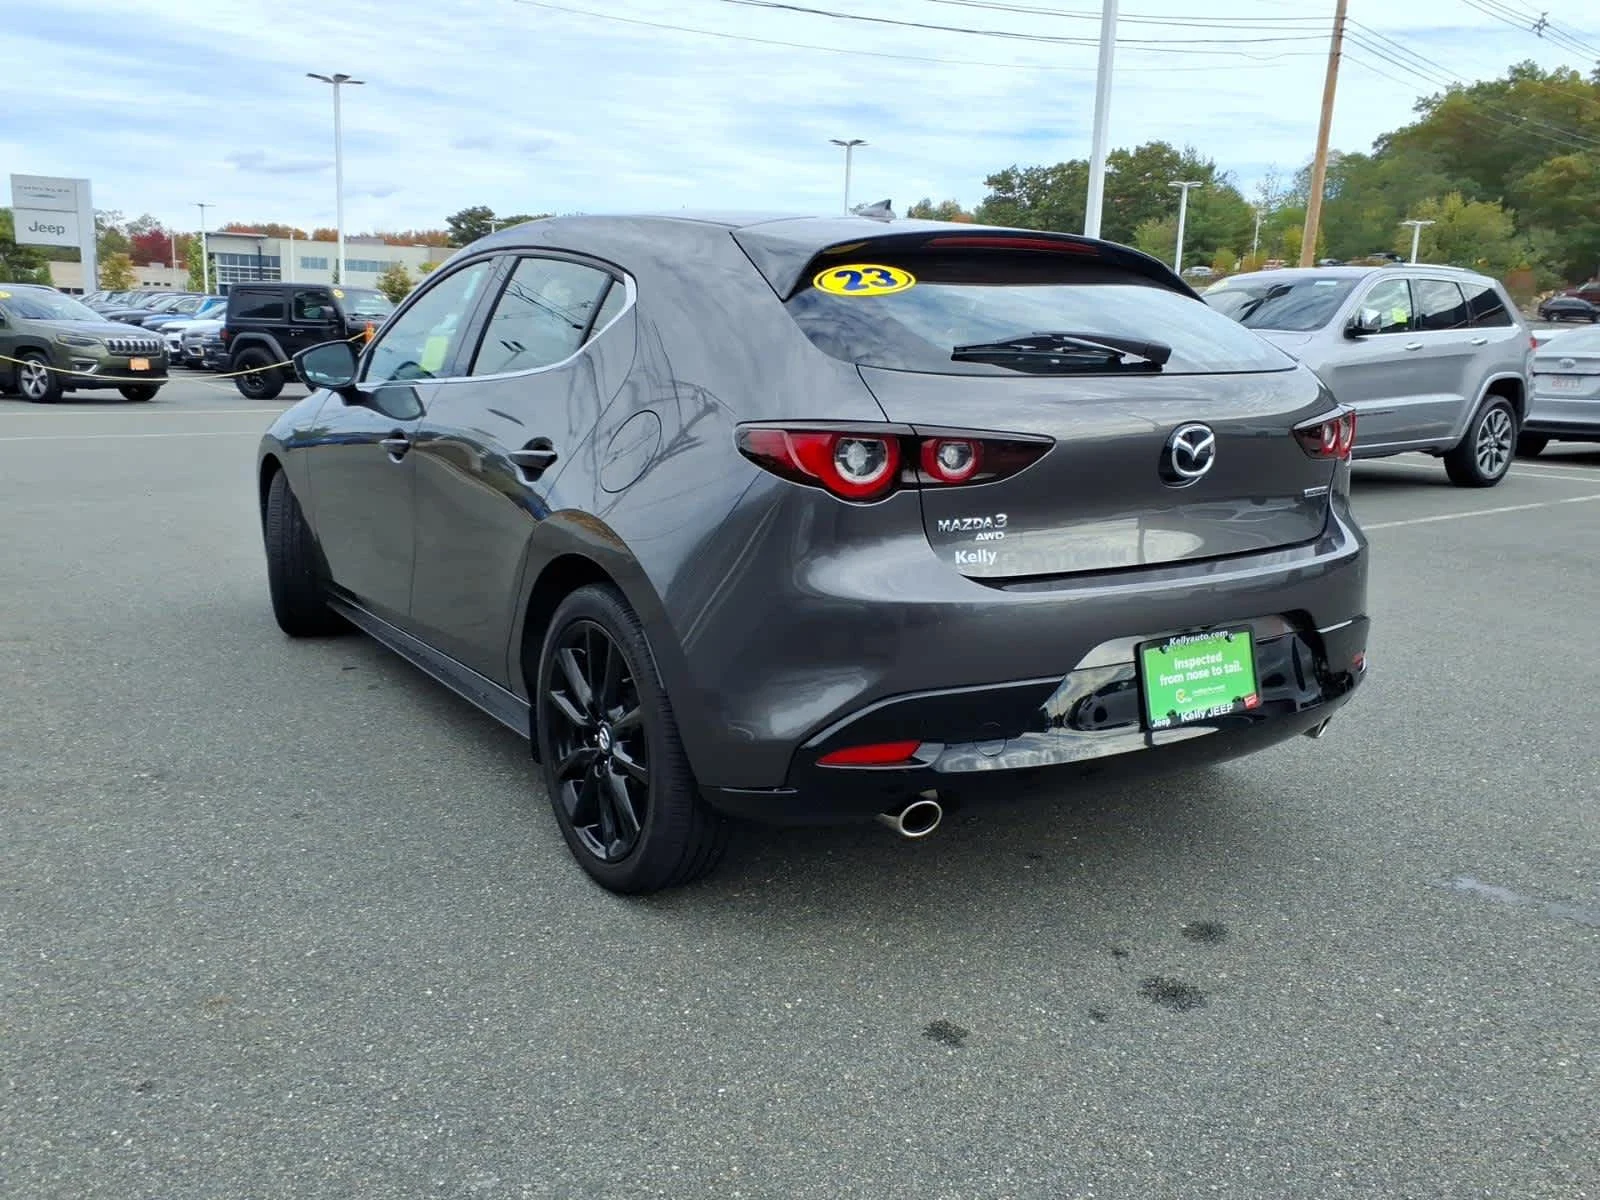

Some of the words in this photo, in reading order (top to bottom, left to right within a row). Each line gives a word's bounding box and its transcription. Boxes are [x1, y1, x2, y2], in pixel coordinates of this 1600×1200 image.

[28, 220, 66, 236] Jeep
[834, 268, 897, 290] 23
[975, 531, 1005, 541] AWD
[954, 548, 997, 566] Kelly
[1169, 631, 1228, 646] Kellyauto.com
[1174, 652, 1222, 669] Inspected
[1160, 674, 1184, 686] from
[1186, 669, 1210, 681] nose
[1211, 665, 1223, 676] to
[1224, 661, 1242, 673] tail.
[1181, 709, 1206, 721] Kelly
[1208, 704, 1233, 717] JEEP
